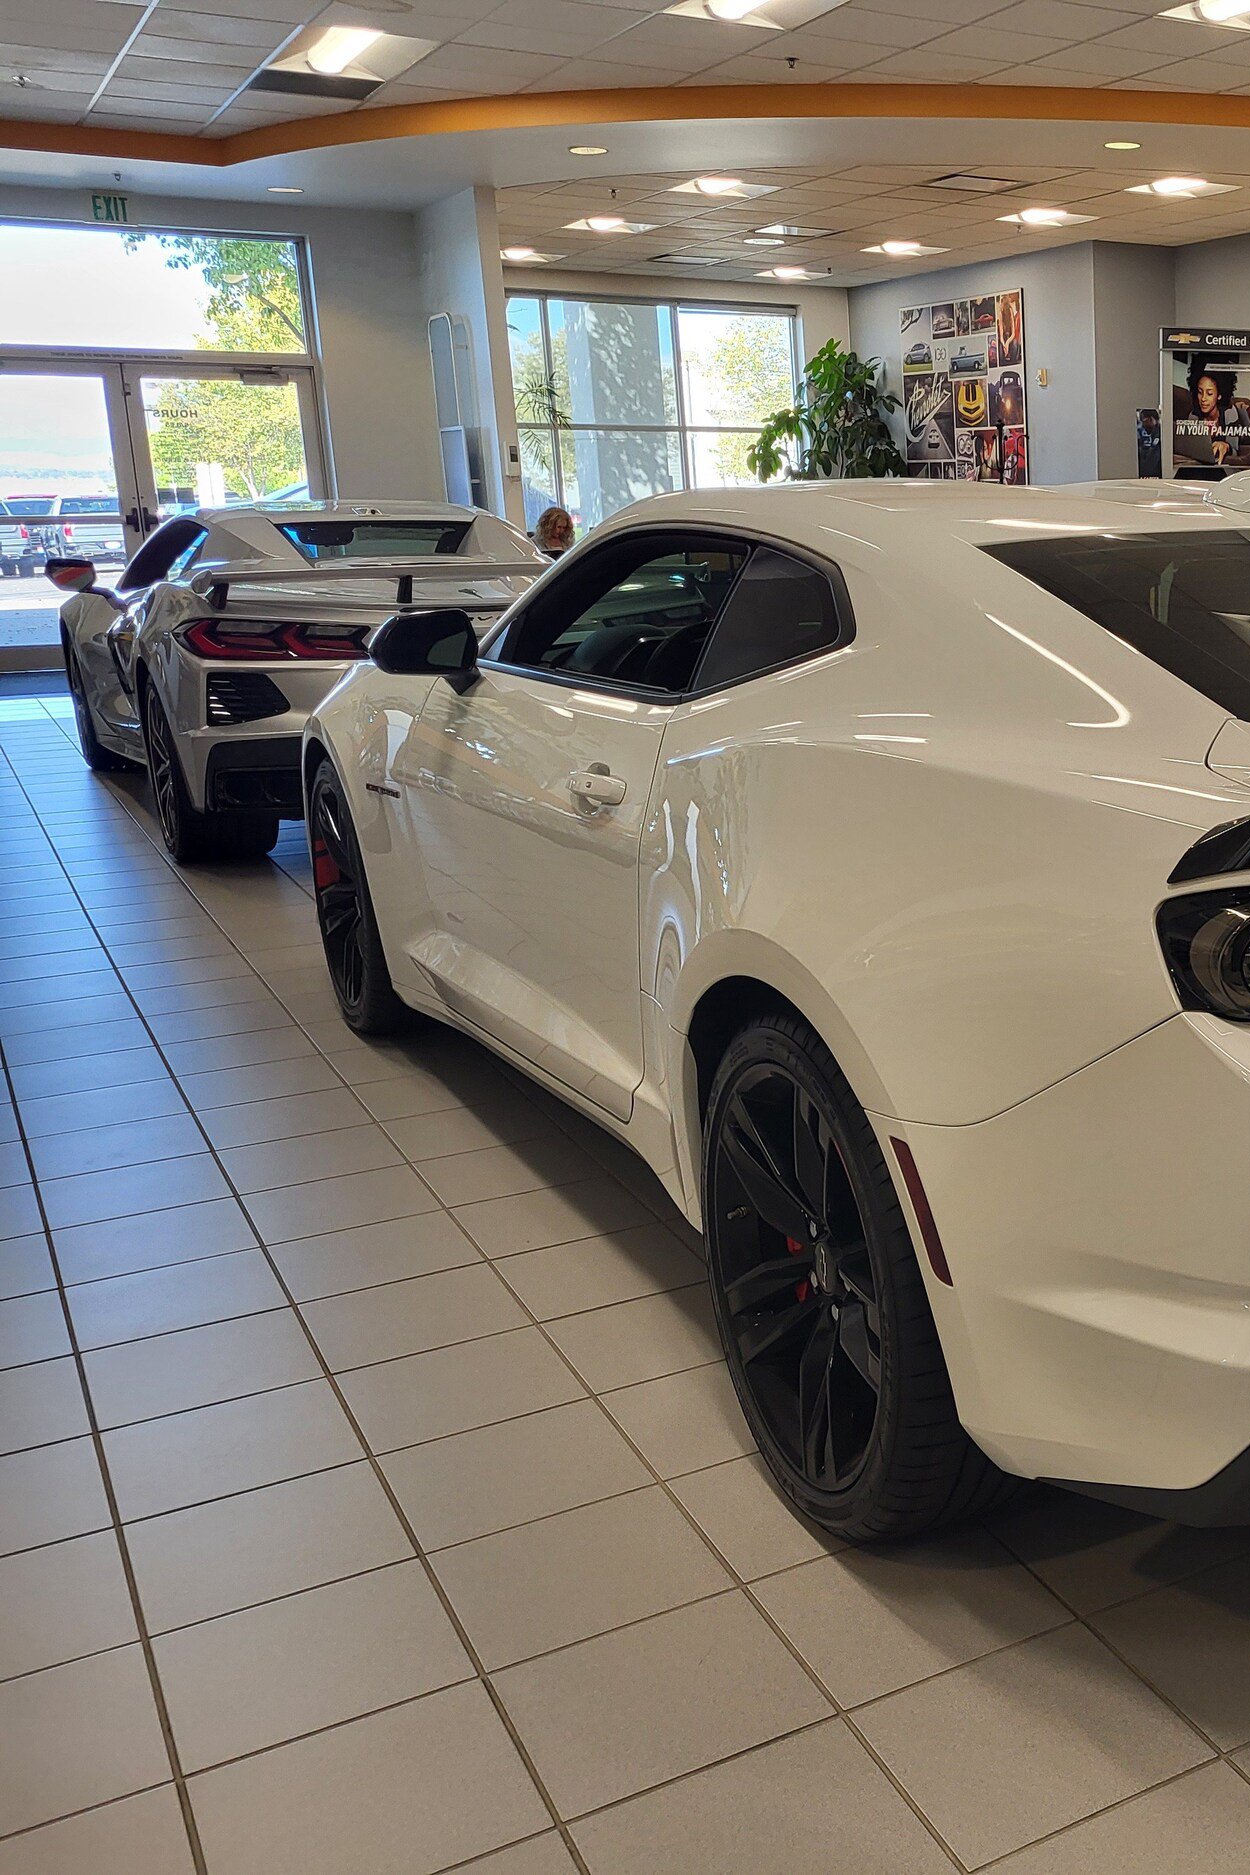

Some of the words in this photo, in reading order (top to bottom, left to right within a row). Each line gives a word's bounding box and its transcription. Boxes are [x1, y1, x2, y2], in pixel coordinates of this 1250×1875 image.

[91, 194, 128, 222] EXIT
[1205, 334, 1247, 347] Certified
[1176, 425, 1185, 435] IN
[1187, 425, 1209, 436] YOUR
